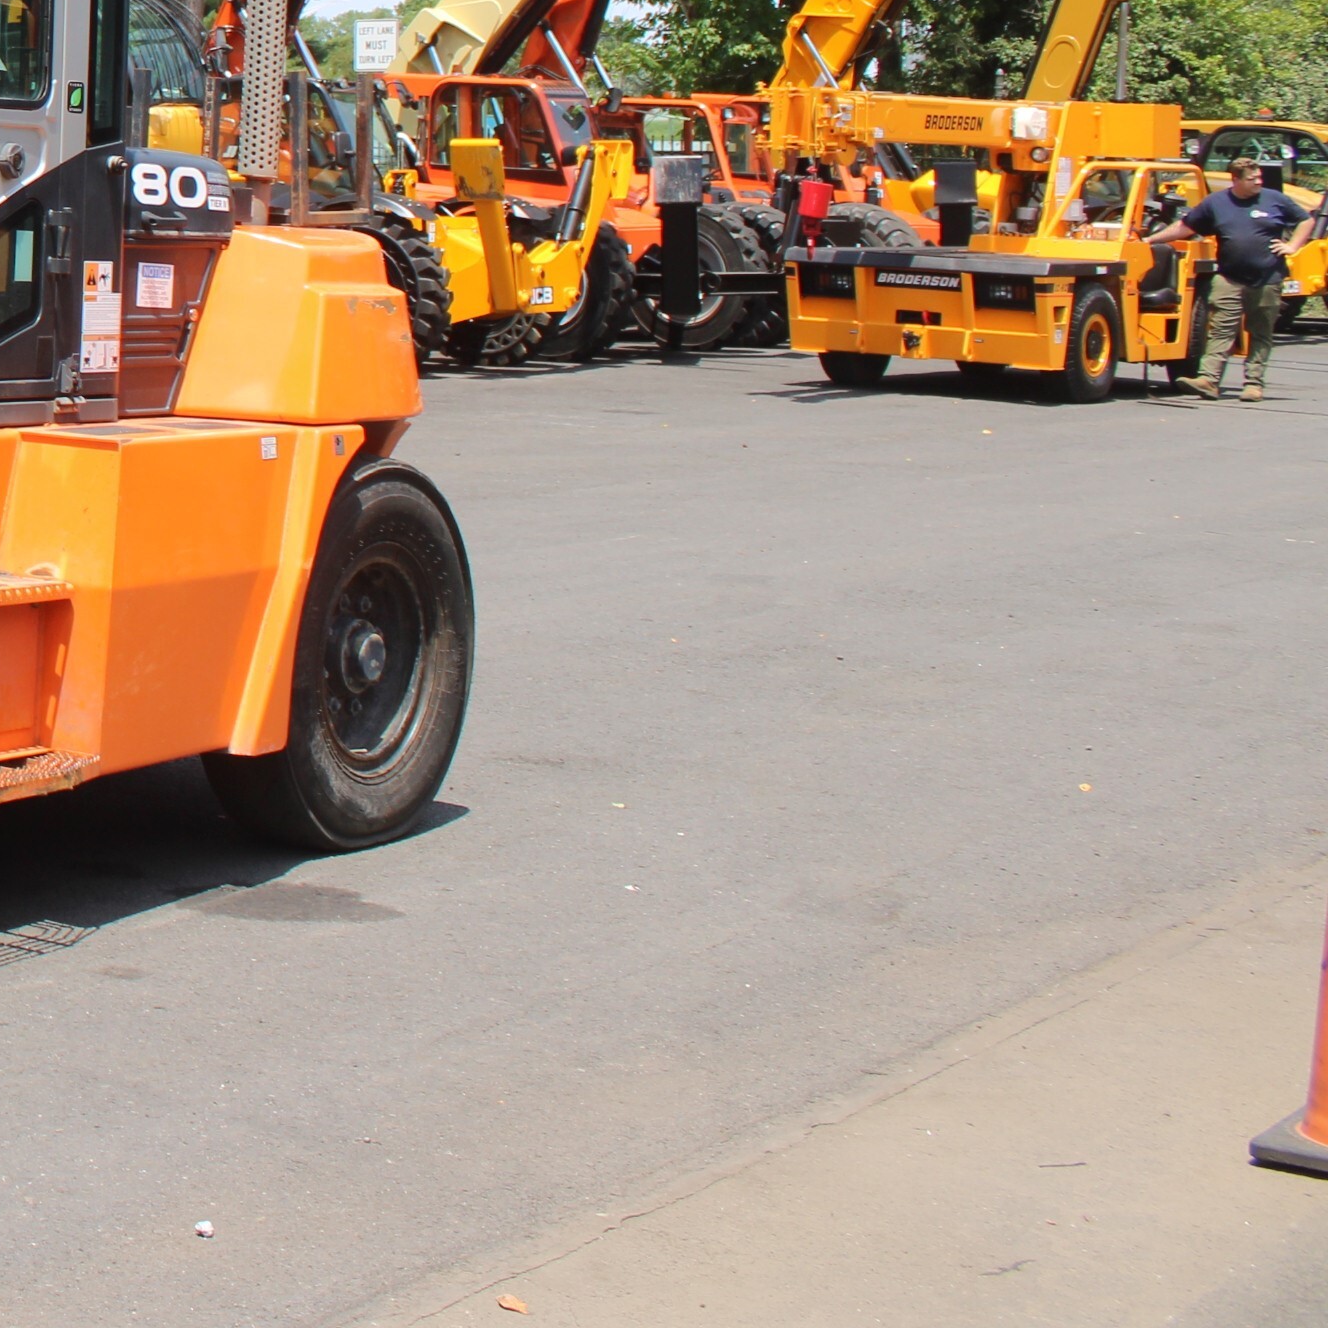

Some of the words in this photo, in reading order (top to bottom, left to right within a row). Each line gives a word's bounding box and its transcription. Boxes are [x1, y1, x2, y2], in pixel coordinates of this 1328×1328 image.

[358, 27, 375, 35] LEFT
[377, 26, 395, 35] LANE
[365, 40, 387, 50] MUST
[924, 114, 984, 131] BRODERSON
[131, 162, 207, 208] 80
[877, 272, 960, 289] BRODERSON
[530, 287, 553, 304] JCB
